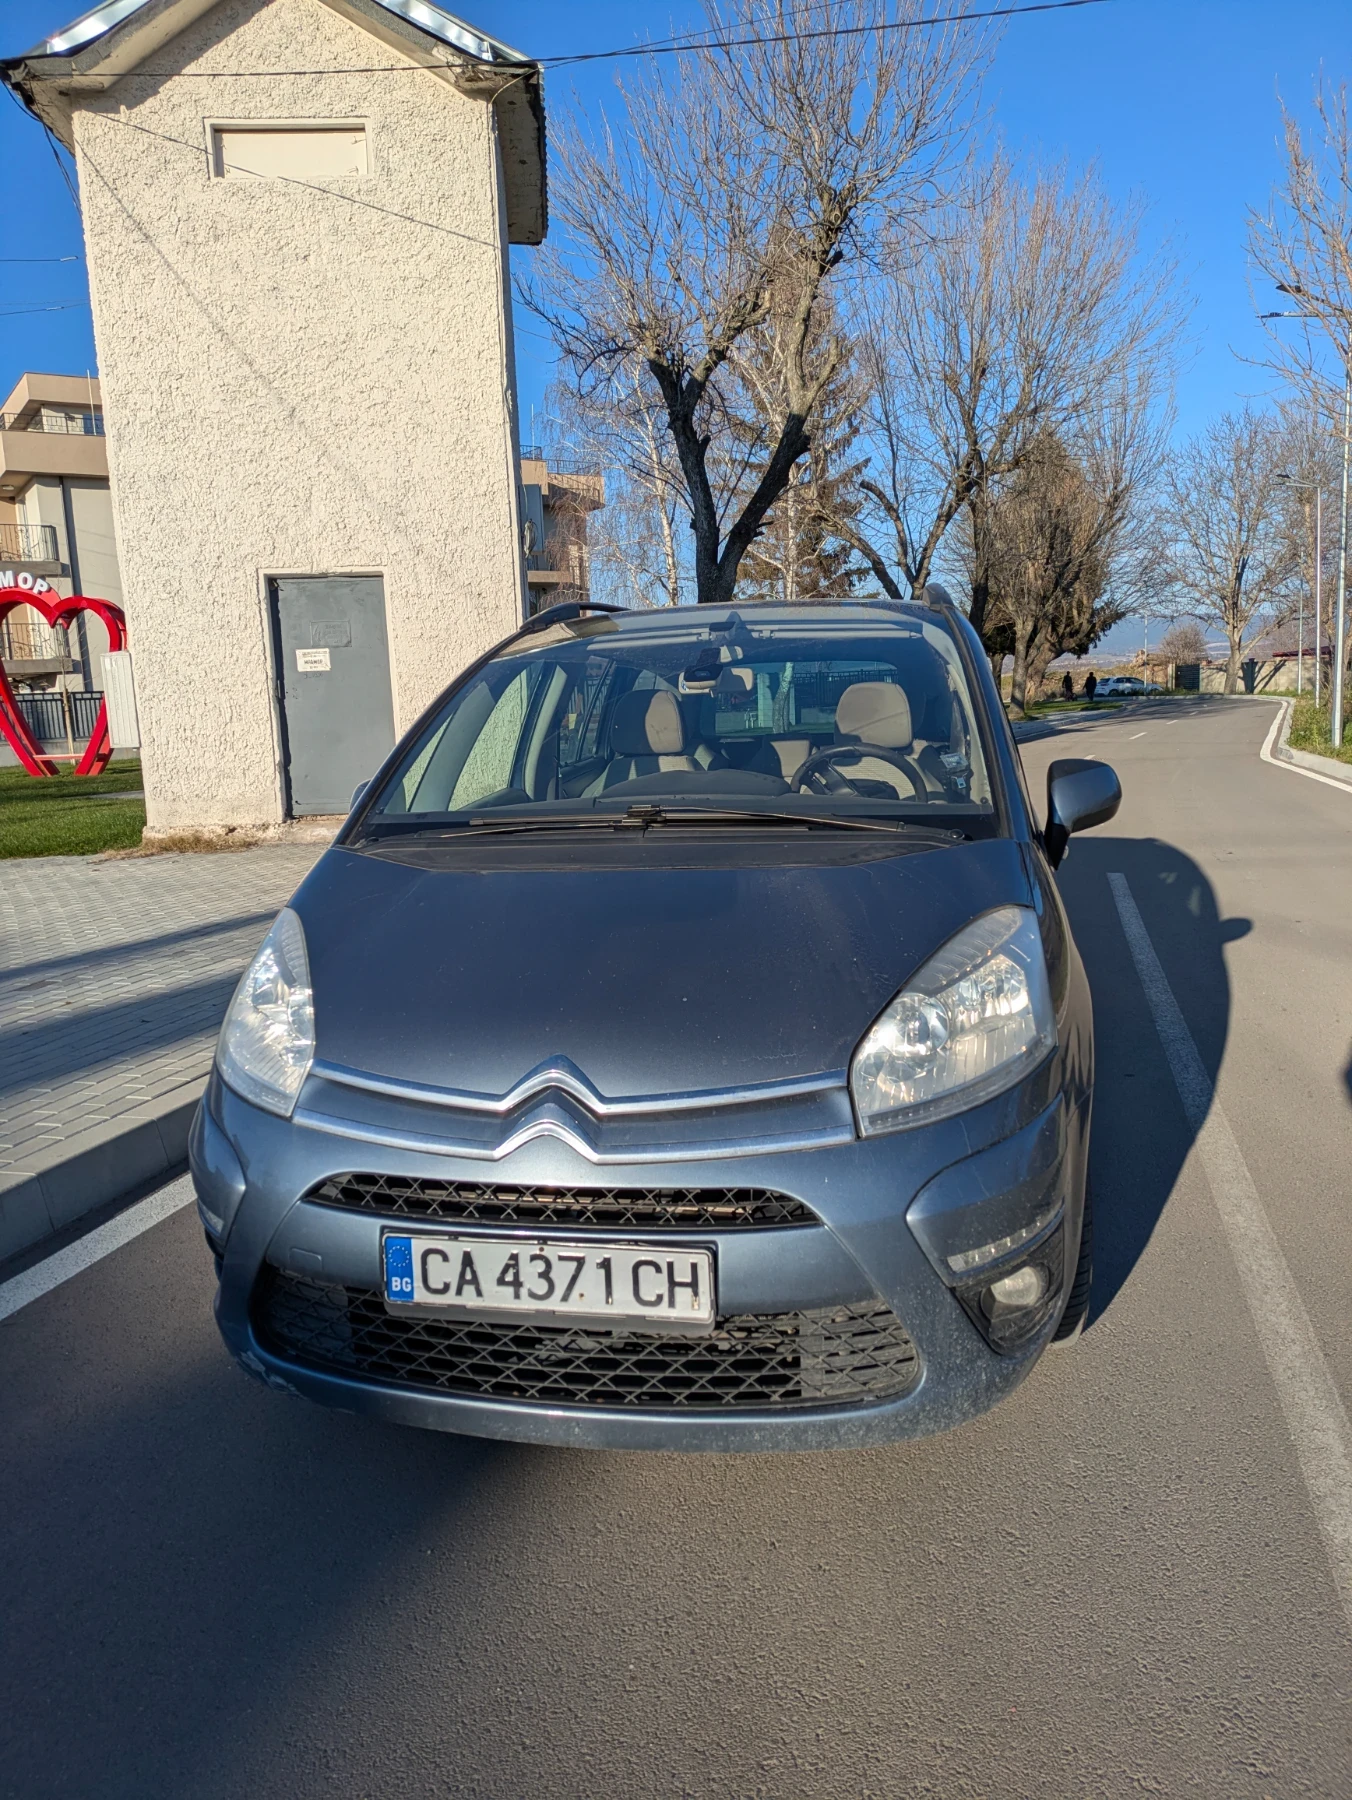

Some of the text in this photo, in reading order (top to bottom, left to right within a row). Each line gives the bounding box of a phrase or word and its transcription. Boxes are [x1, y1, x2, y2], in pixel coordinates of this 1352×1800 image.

[391, 1276, 412, 1293] BG
[420, 1247, 700, 1311] CA 4371 CH
